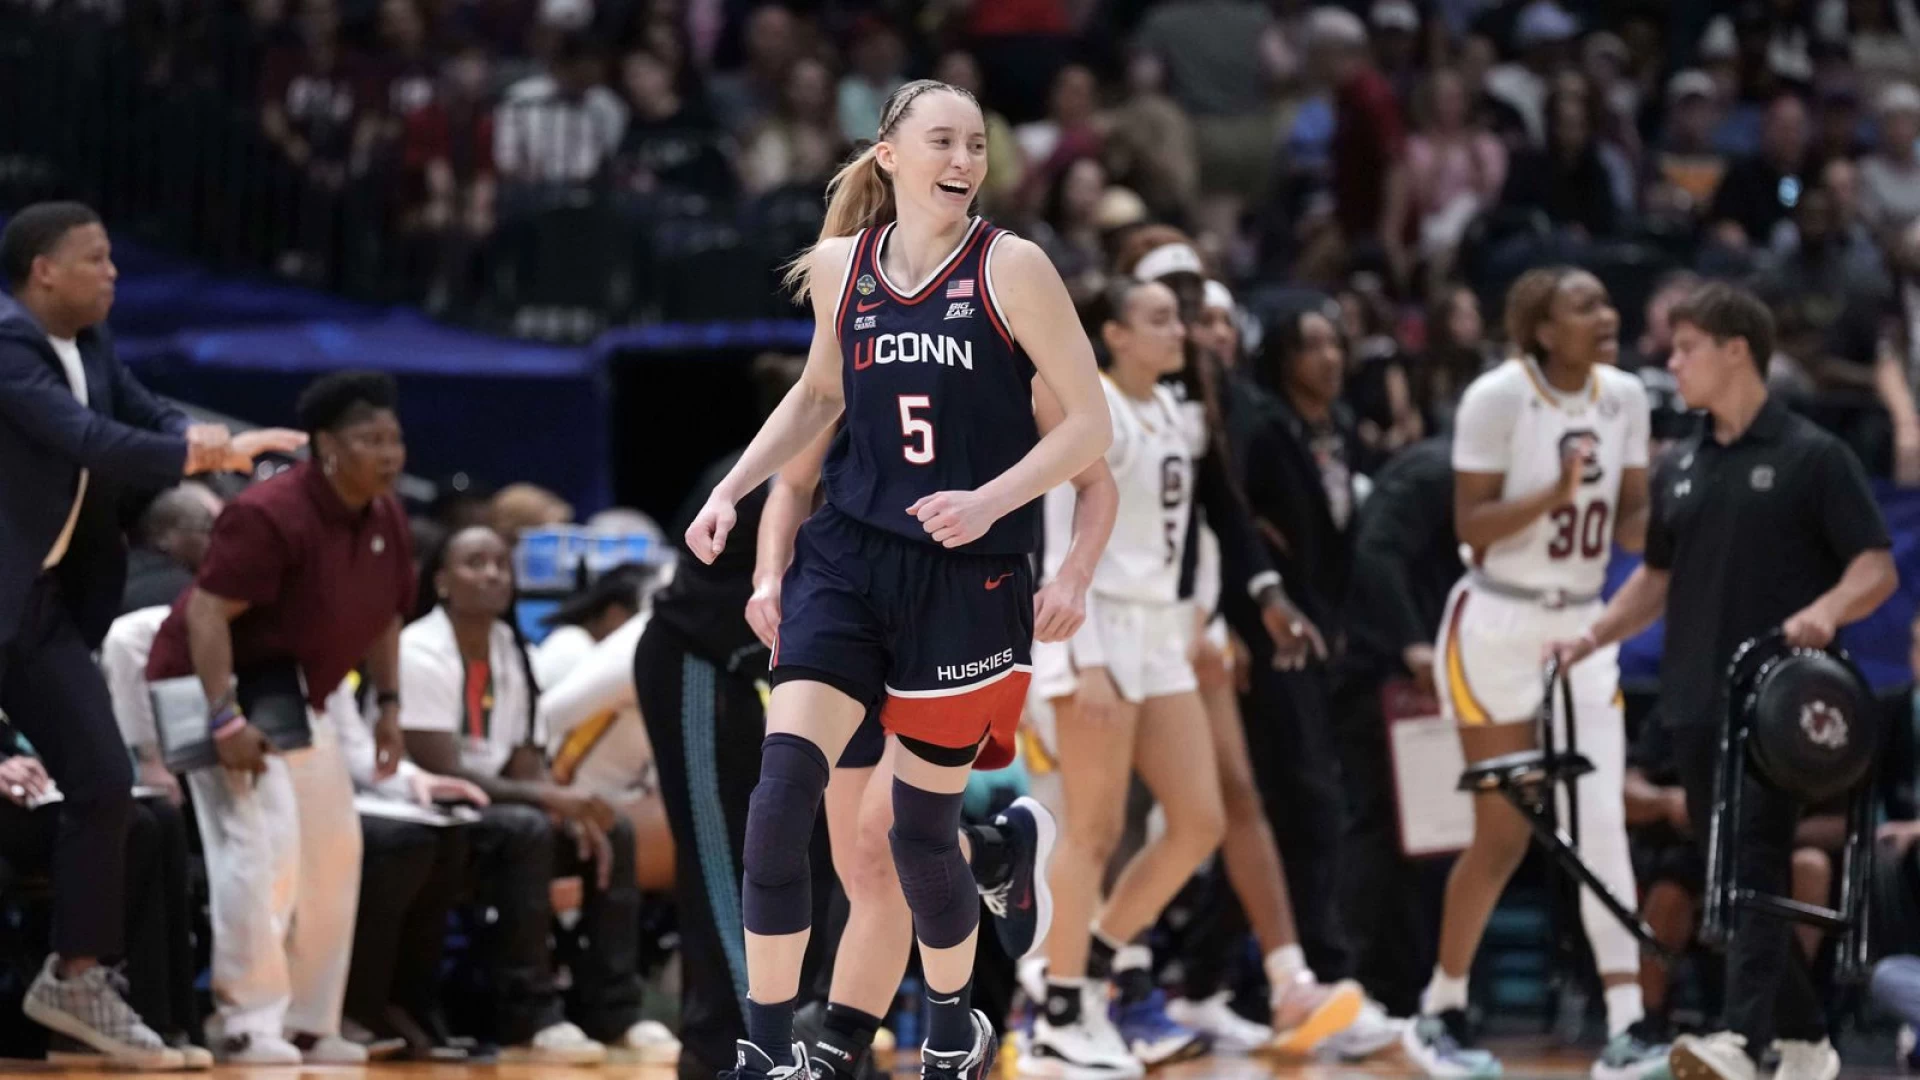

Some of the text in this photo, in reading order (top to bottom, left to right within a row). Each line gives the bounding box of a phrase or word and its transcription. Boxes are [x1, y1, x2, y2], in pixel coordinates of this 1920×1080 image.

[854, 331, 973, 371] UCONN
[898, 394, 936, 465] 5
[1548, 499, 1608, 559] 30
[937, 647, 1013, 681] HUSKIES
